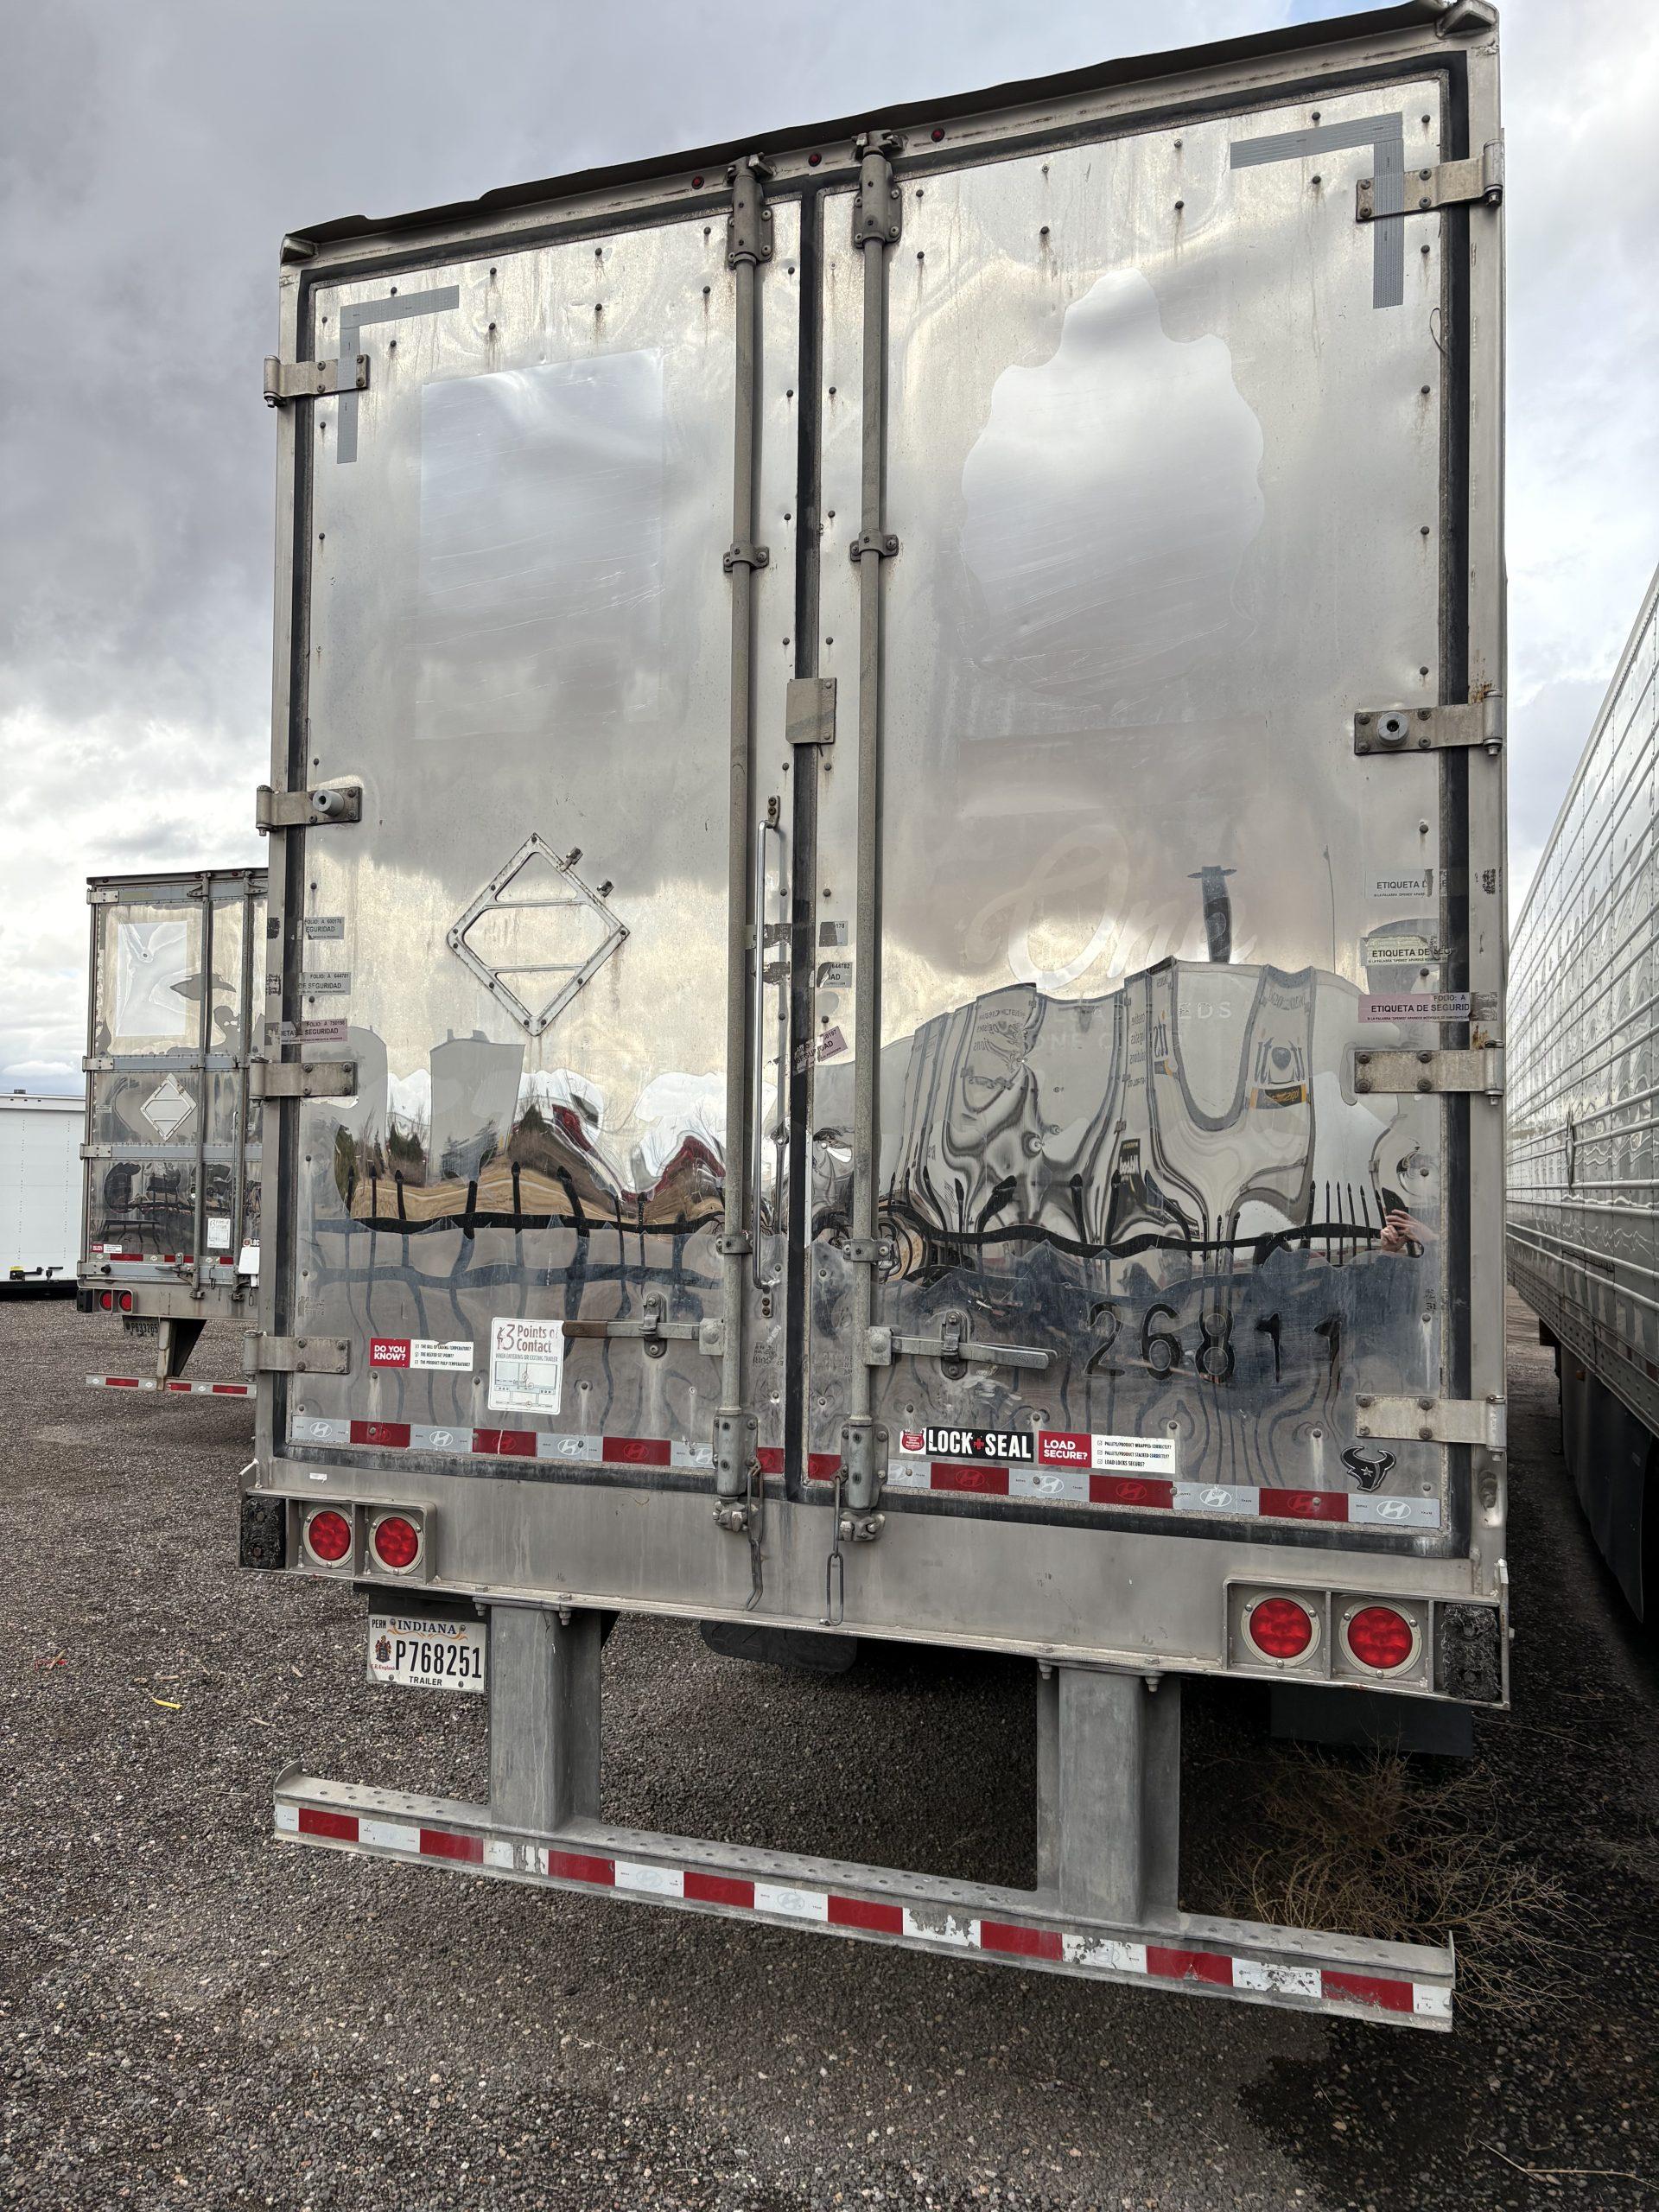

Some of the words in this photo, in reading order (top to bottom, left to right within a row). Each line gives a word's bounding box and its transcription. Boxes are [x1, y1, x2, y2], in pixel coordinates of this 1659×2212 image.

[1376, 880, 1420, 889] ETIQUETA
[1372, 949, 1415, 958] ETIQUETA
[1418, 948, 1430, 957] DE
[1371, 1004, 1414, 1013] ETIQUETA
[1431, 1003, 1470, 1012] SEGURID
[503, 1324, 516, 1351] 3
[517, 1325, 547, 1339] Points
[374, 1344, 387, 1353] DO
[516, 1338, 552, 1353] Contact
[373, 1352, 406, 1361] KNOW?
[1044, 1439, 1076, 1451] LOAD
[1044, 1449, 1088, 1460] SECURE?
[372, 1618, 387, 1629] PERM
[397, 1619, 457, 1635] INDIANA
[395, 1639, 482, 1679] P768251
[409, 1675, 442, 1687] TRAILER
